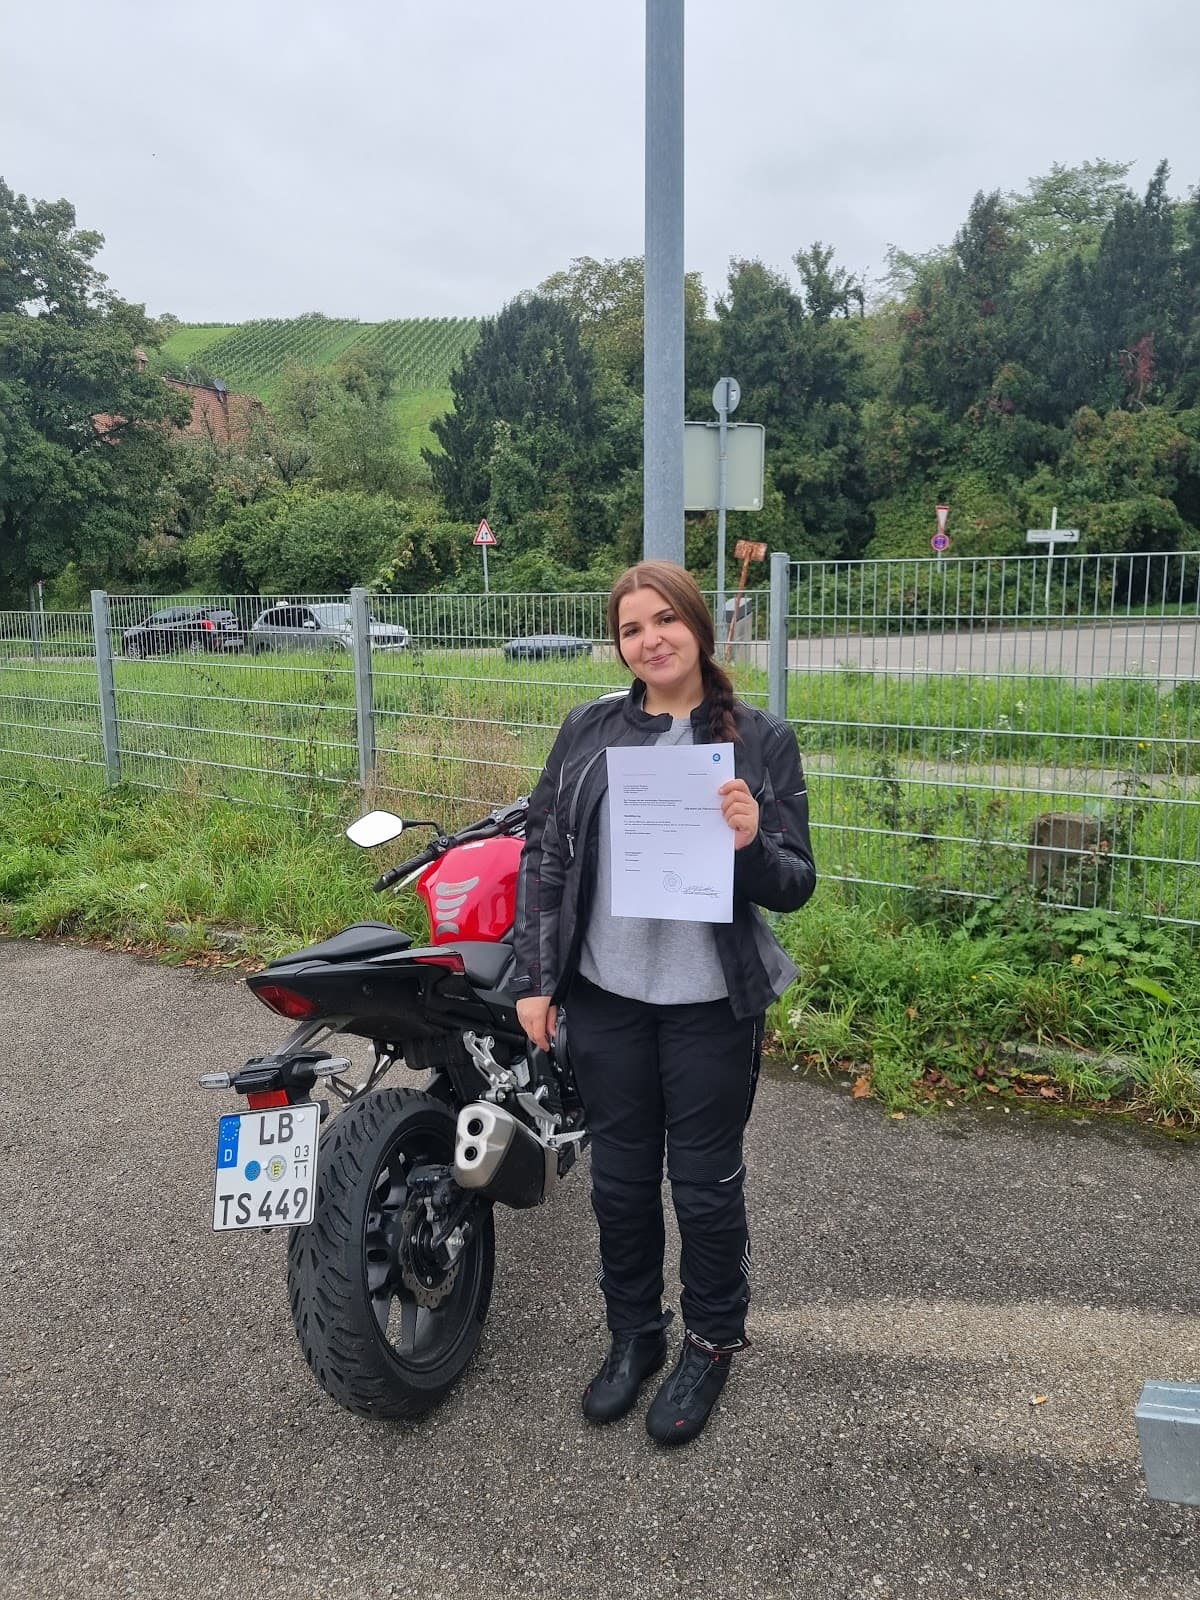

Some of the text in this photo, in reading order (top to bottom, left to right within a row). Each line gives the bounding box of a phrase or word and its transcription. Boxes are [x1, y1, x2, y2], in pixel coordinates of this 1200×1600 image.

[259, 1112, 294, 1145] LB
[223, 1148, 233, 1162] D
[294, 1144, 310, 1158] 03
[294, 1164, 308, 1179] 11
